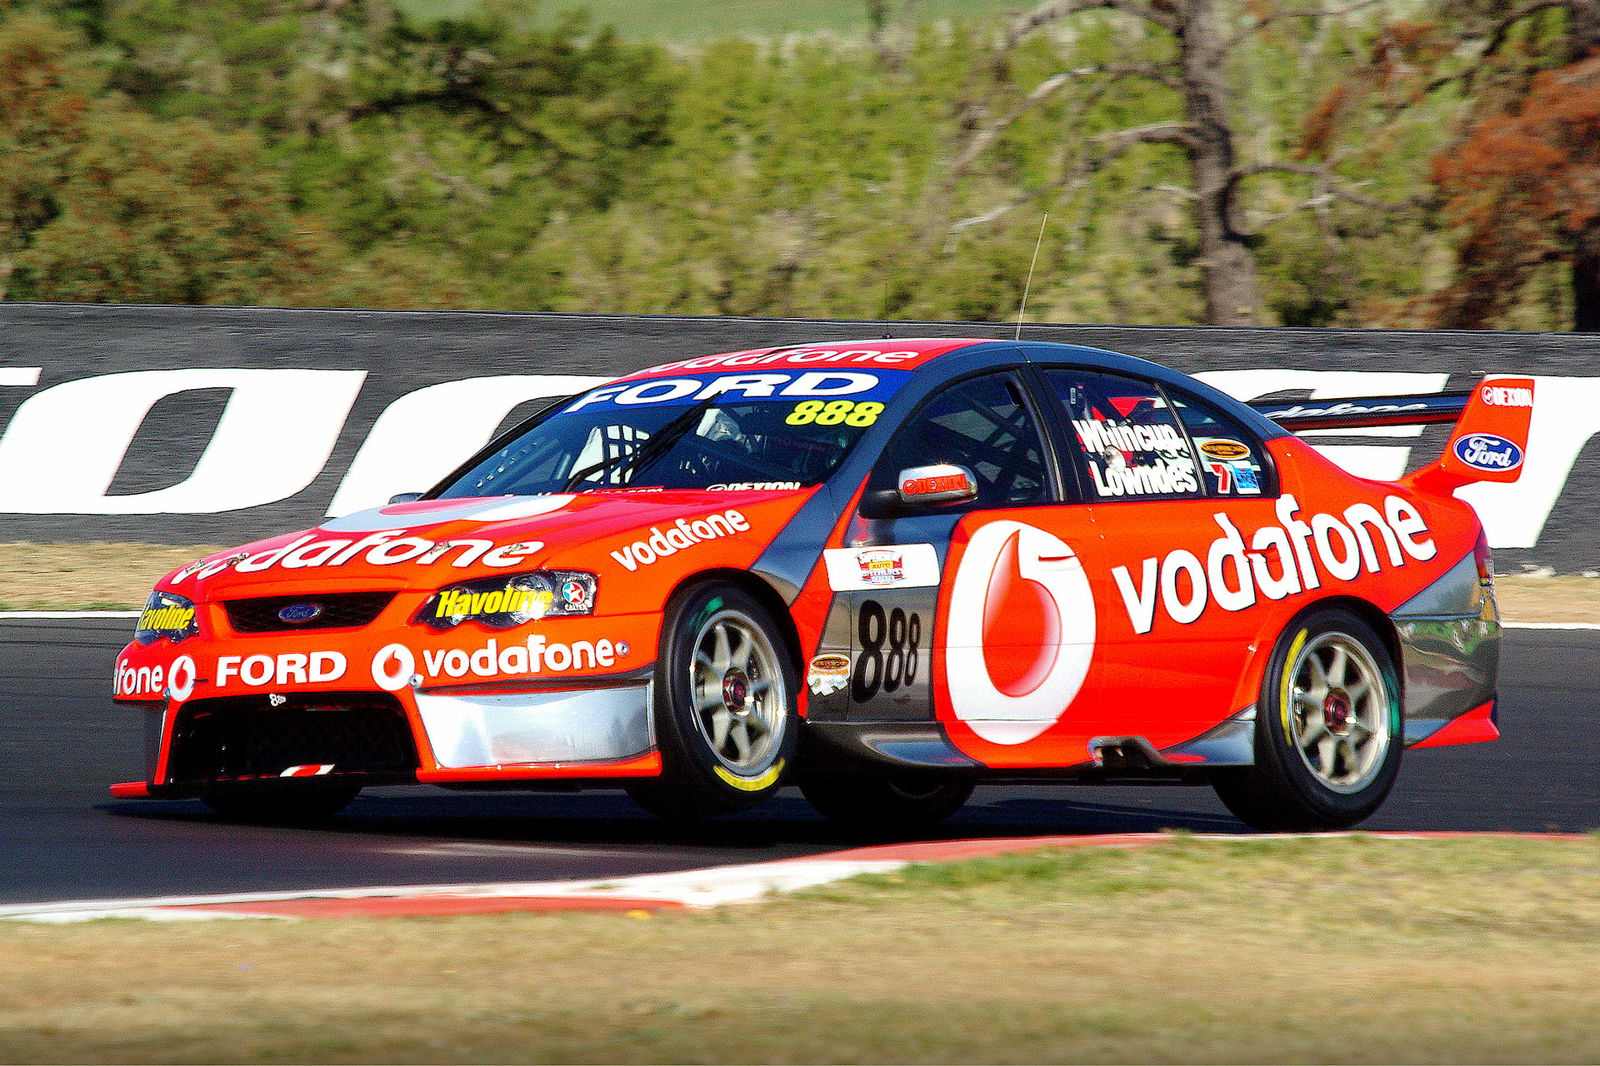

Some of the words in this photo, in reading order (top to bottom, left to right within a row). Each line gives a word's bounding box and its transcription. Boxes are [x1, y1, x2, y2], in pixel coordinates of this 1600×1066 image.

[564, 372, 879, 413] FORD
[784, 400, 885, 427] 888
[1464, 436, 1513, 467] Ford
[1089, 459, 1198, 497] Lowndes
[170, 529, 545, 585] vodafone
[610, 510, 750, 572] vodafone
[1111, 493, 1437, 634] vodafone
[435, 587, 554, 618] Havoline
[216, 651, 347, 687] FORD
[423, 634, 614, 677] vodafone
[852, 600, 921, 703] 888
